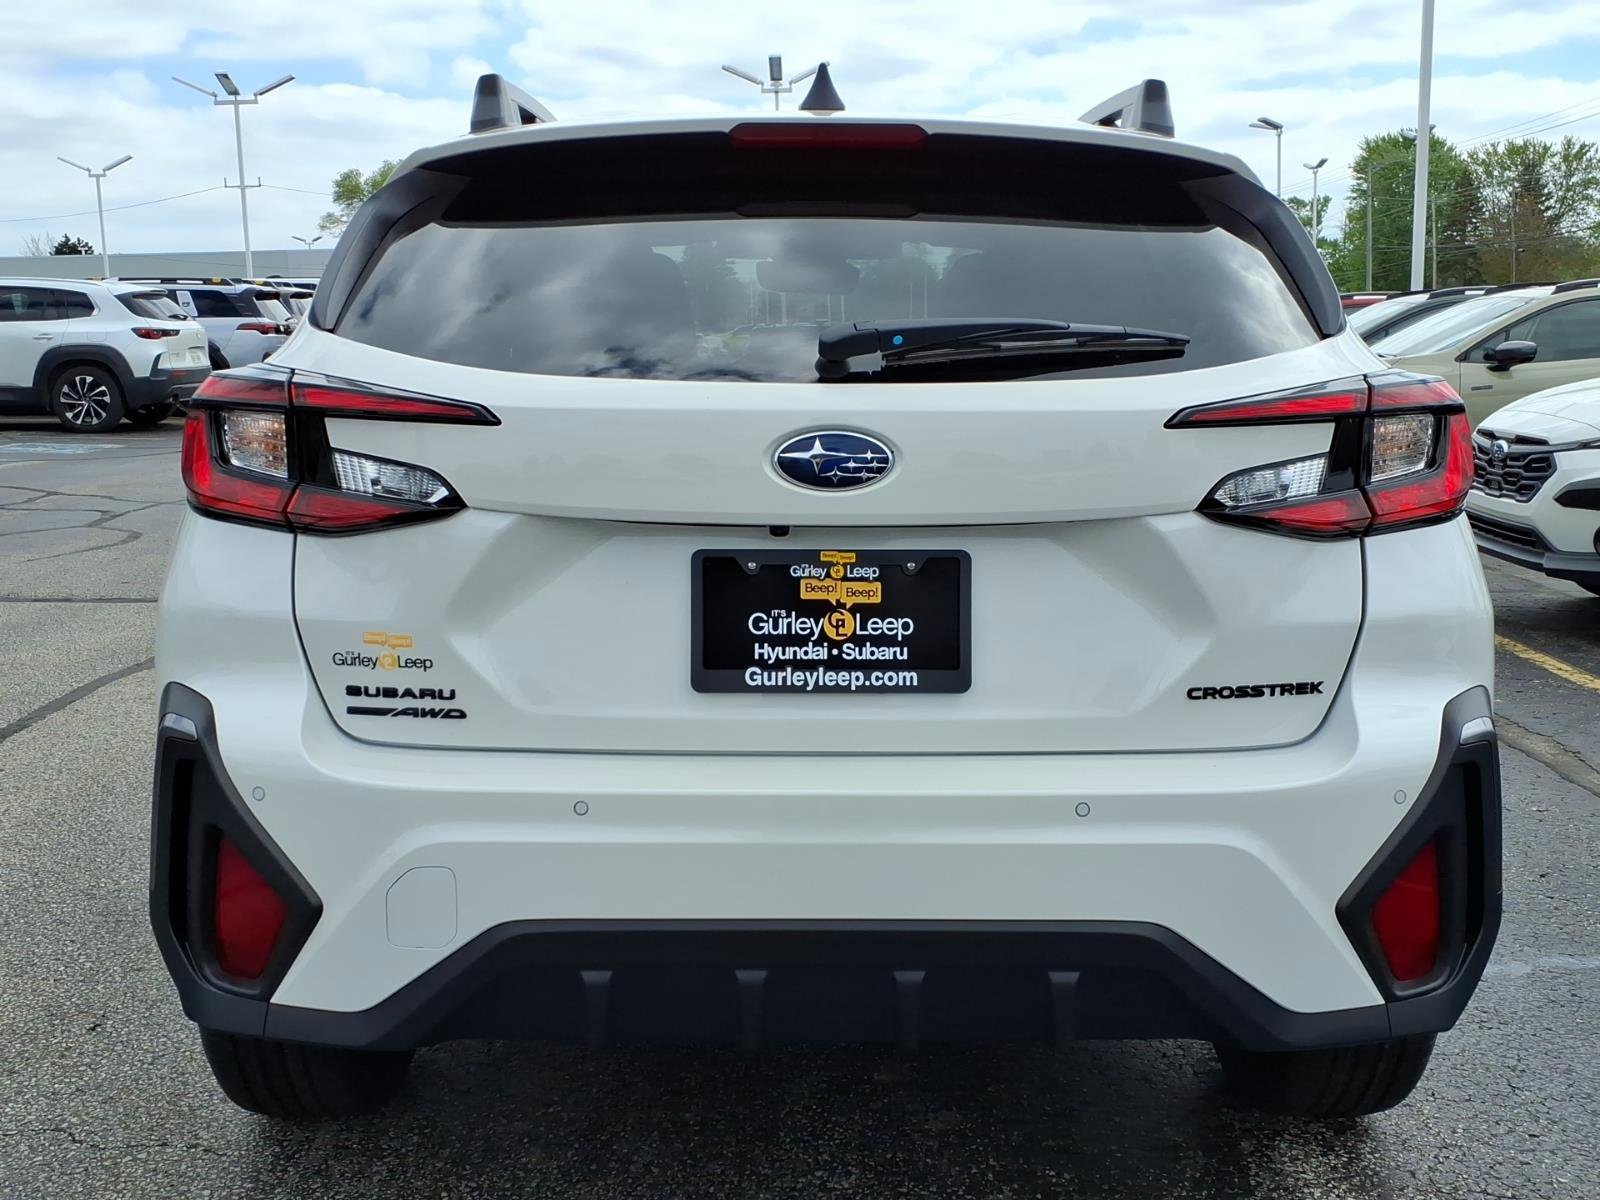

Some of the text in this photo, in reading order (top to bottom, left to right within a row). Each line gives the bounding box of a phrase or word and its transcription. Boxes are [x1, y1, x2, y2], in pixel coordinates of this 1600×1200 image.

[846, 565, 880, 581] Leep
[804, 582, 879, 601] Beep! Beep!
[748, 611, 825, 641] Gurley
[855, 613, 914, 641] Leep
[753, 642, 908, 664] Hyundai Subaru
[397, 655, 434, 672] Leep
[744, 666, 918, 691] Gurleyleep.com
[345, 684, 456, 701] SUBARU
[1186, 680, 1325, 700] CROSSTREK
[390, 707, 467, 720] AWD
